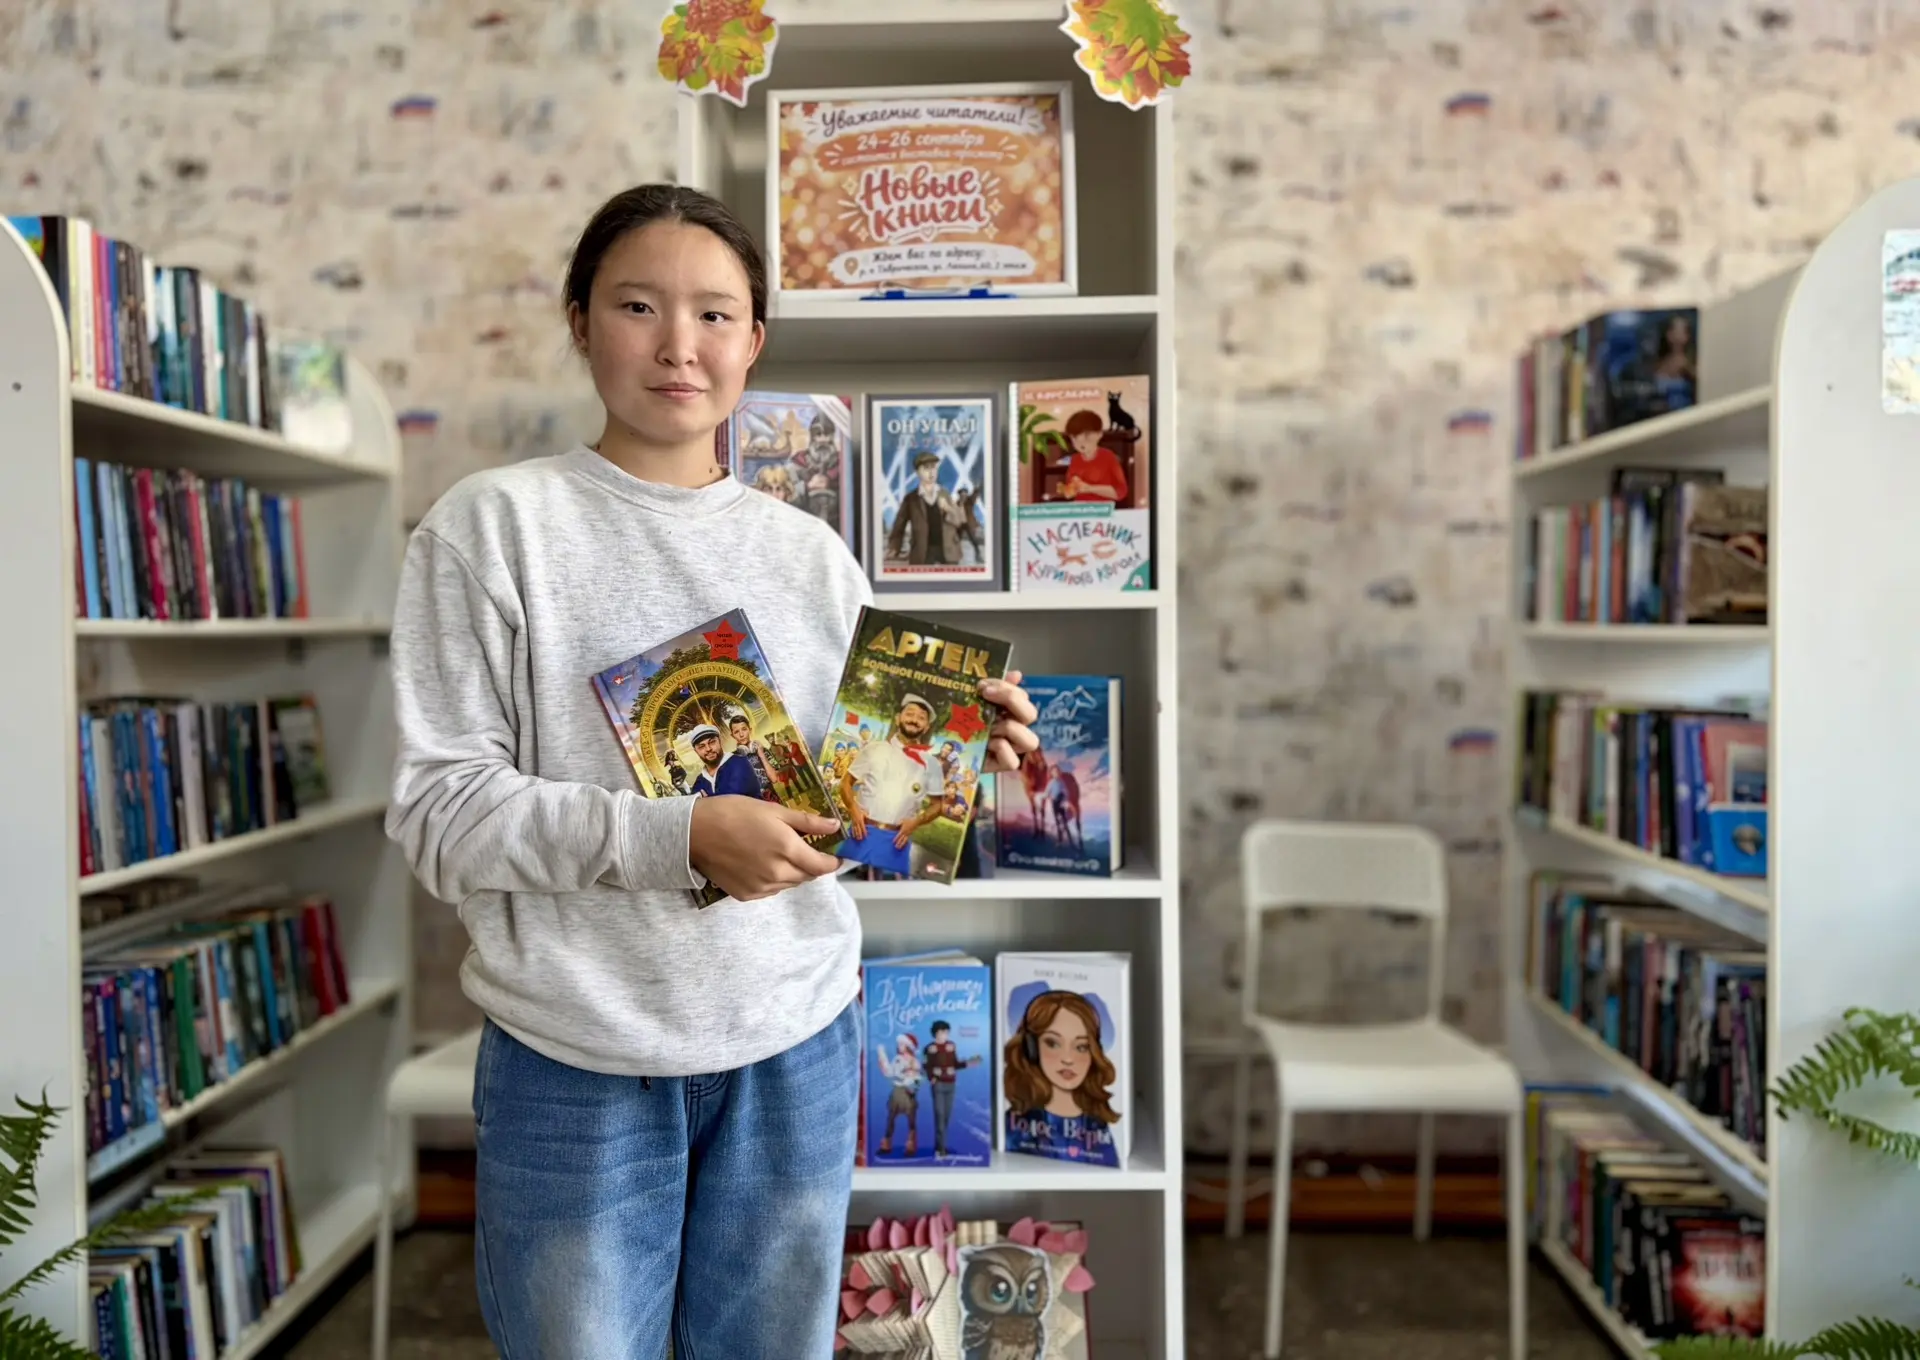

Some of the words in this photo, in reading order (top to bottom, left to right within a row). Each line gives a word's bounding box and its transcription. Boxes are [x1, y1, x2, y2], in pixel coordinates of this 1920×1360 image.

[822, 106, 922, 137] Уважаемые
[926, 106, 1026, 125] читатели!
[915, 129, 985, 150] сентября
[861, 164, 977, 210] Новые
[871, 198, 986, 237] книги
[907, 248, 925, 260] вас
[929, 250, 941, 259] по
[887, 417, 915, 434] ОН
[919, 417, 978, 434] УПАЛ
[1027, 521, 1142, 554] НАСЛЕДНИК
[867, 625, 990, 680] АРТЕК
[862, 657, 914, 679] БОЛЬШОЕ
[913, 670, 979, 694] ПУТЕШЕСТВ
